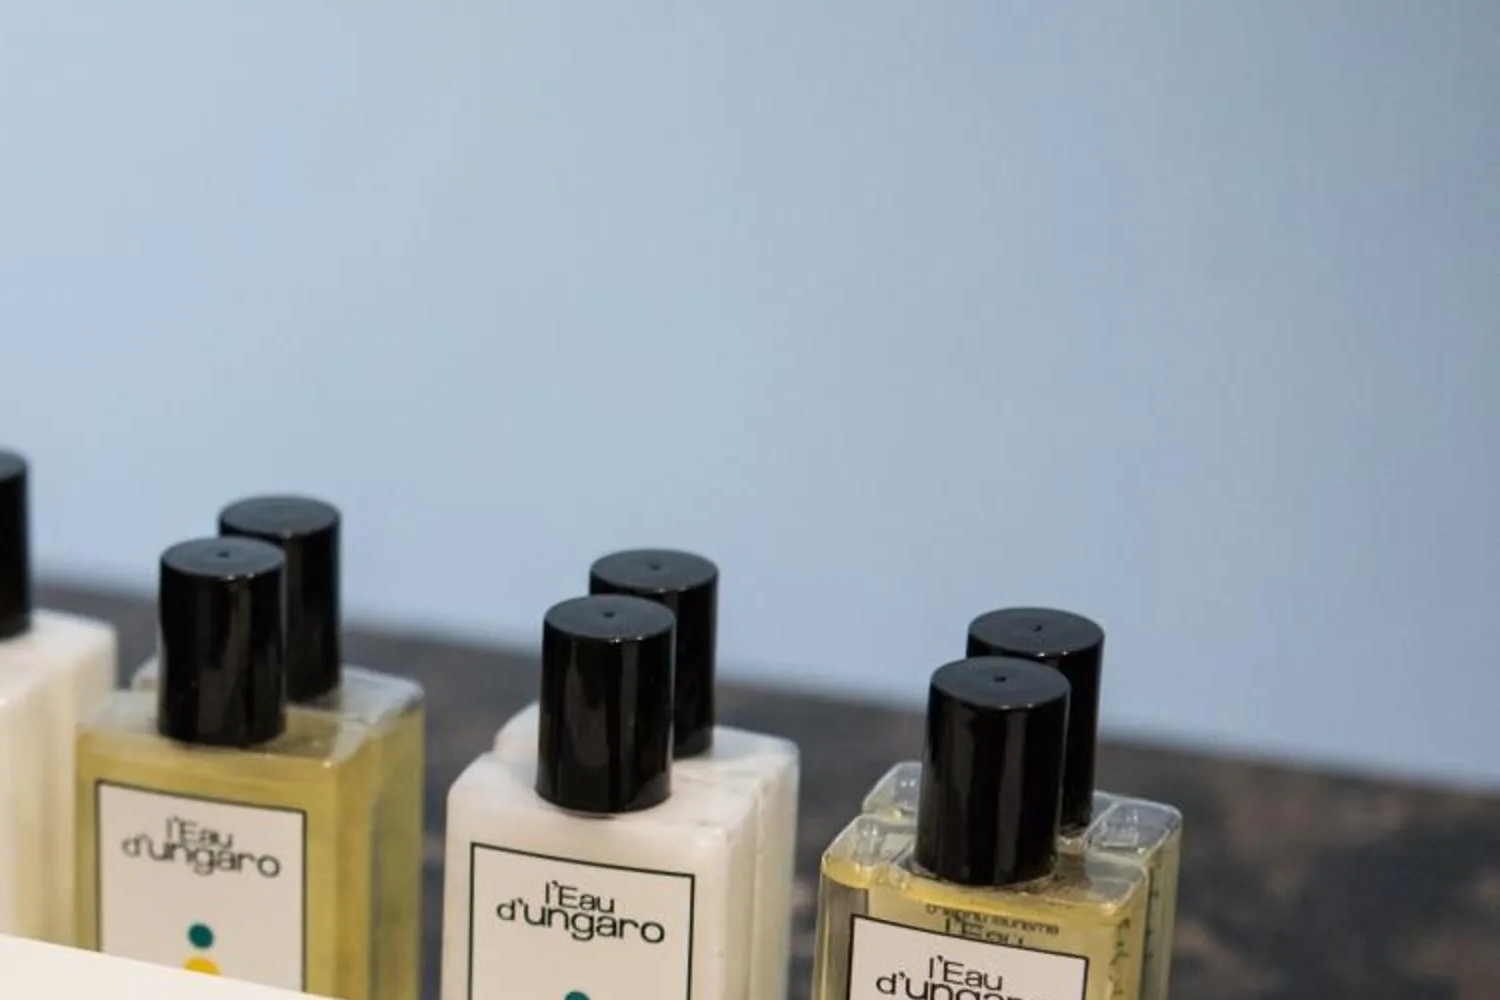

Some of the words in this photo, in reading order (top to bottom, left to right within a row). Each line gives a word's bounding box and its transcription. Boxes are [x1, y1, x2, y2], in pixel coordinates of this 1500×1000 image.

[166, 816, 233, 850] l'Eau
[120, 833, 281, 878] d'ungaro
[545, 880, 615, 913] l'Eau
[496, 897, 666, 944] d'ungaro
[928, 955, 1003, 991] l'Eau
